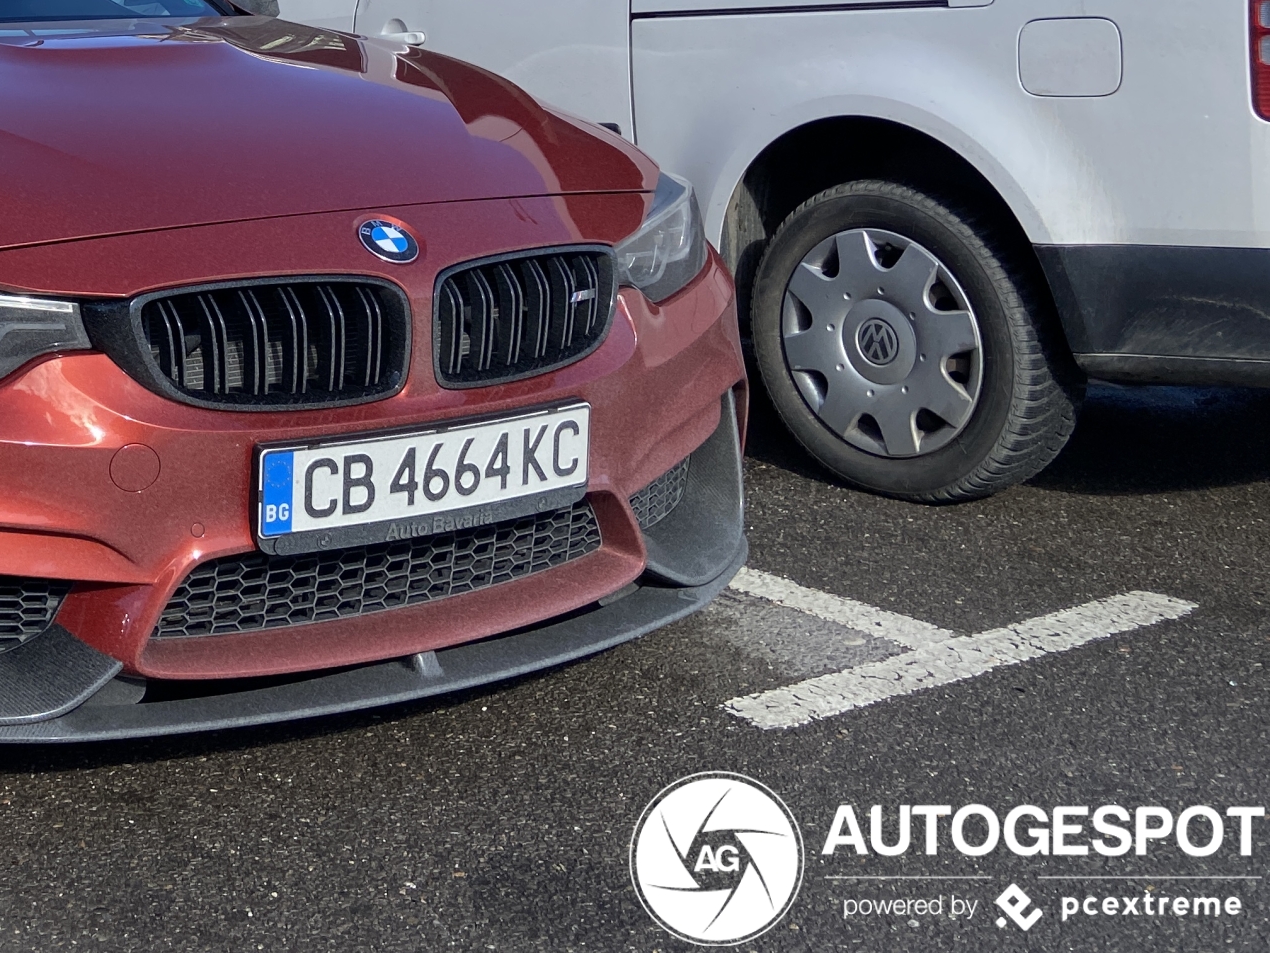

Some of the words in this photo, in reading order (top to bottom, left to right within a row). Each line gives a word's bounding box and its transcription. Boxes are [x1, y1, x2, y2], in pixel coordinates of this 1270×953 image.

[303, 453, 376, 518] CB
[389, 432, 511, 506] 4664
[521, 419, 580, 486] KC
[266, 503, 290, 523] BG
[385, 521, 429, 541] Auto
[431, 508, 493, 534] Bavaria
